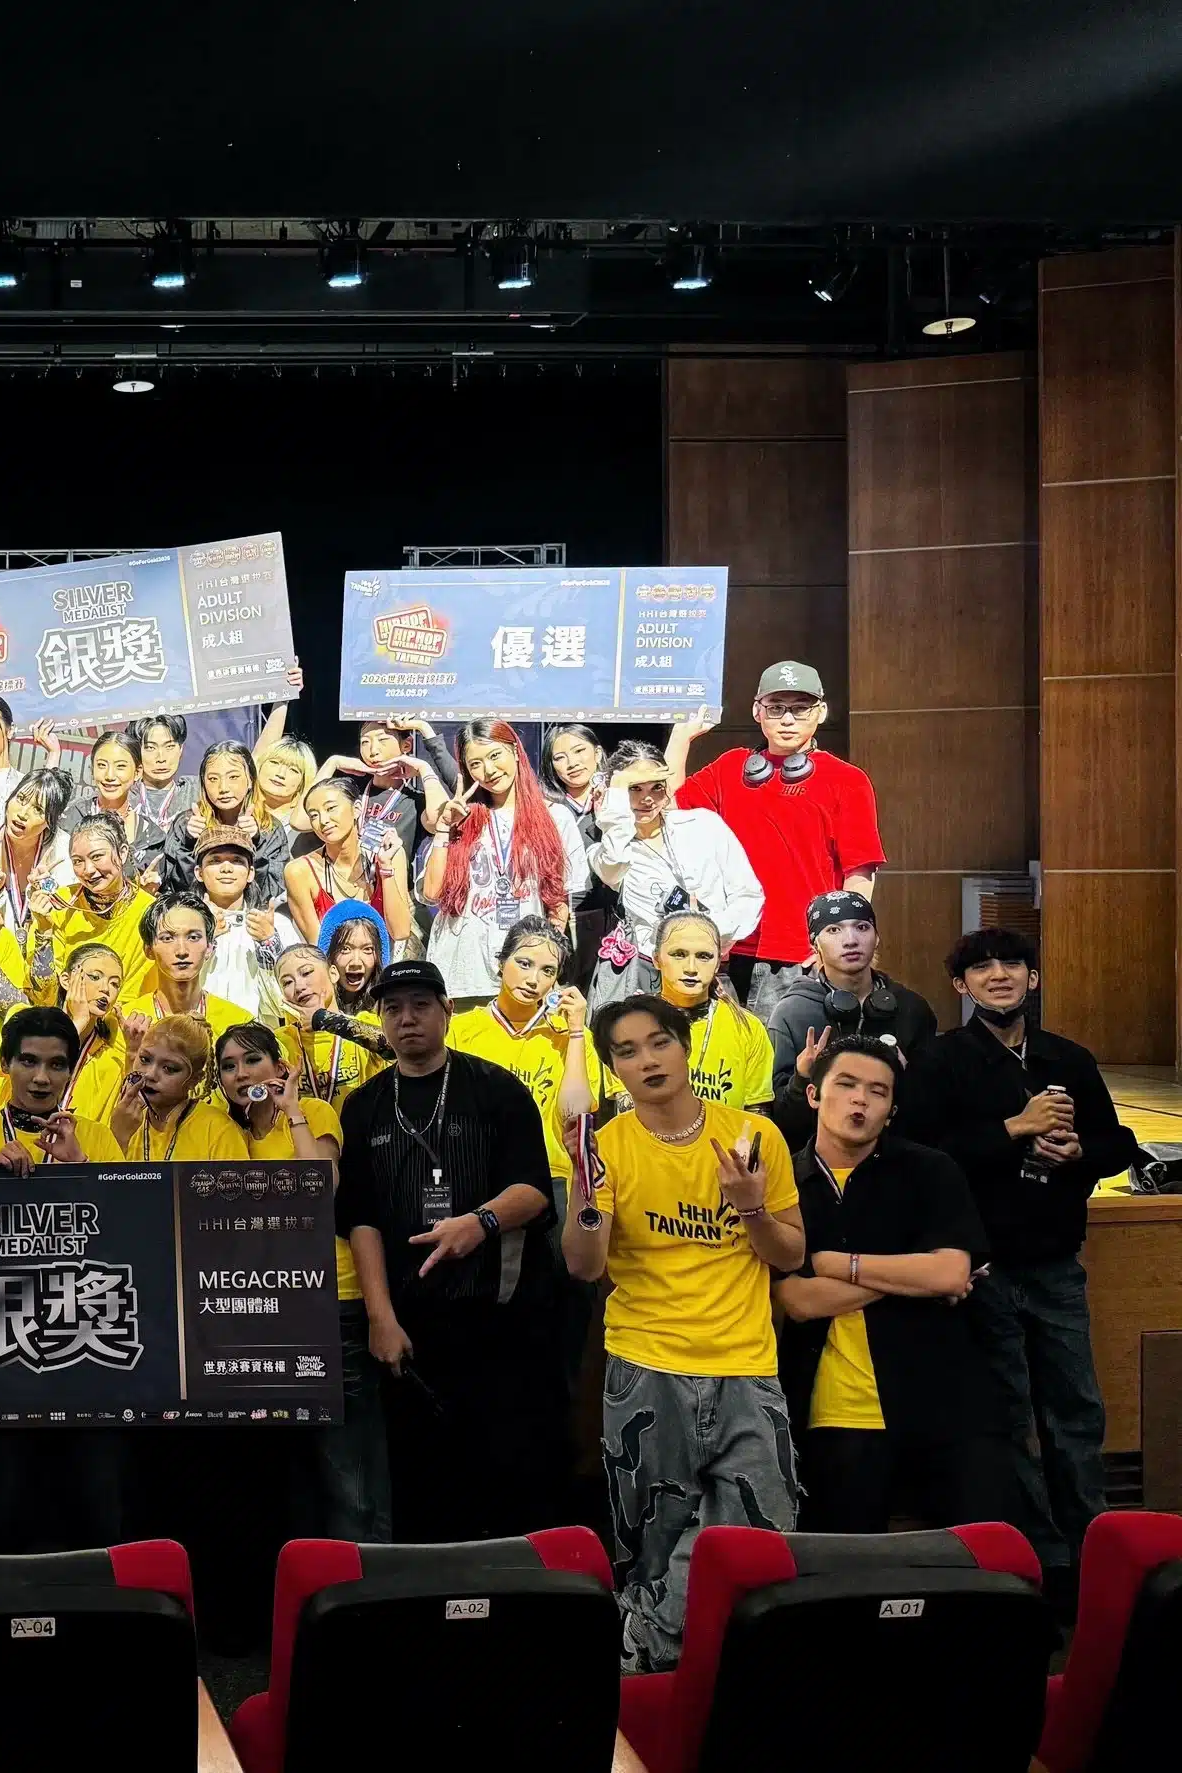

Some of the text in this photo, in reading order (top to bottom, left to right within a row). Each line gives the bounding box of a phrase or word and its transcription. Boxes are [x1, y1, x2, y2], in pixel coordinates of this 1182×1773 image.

[52, 581, 133, 612] SILVER
[197, 591, 243, 609] ADULT
[62, 602, 127, 623] MEDALIST
[199, 605, 262, 625] DIVISION
[636, 623, 678, 634] ADULT
[202, 630, 243, 649] 成人組
[394, 628, 443, 646] HIP HOP
[636, 637, 693, 648] DIVISION
[491, 625, 586, 670] 優選
[39, 620, 163, 694] 銀獎
[395, 652, 432, 665] TAIWAN
[634, 655, 672, 668] 成人組
[386, 688, 429, 697] 2026.05.09
[782, 785, 806, 797] HUF
[391, 967, 421, 978] Supreme
[98, 1173, 162, 1181] #GoForGold2026
[246, 1183, 267, 1192] DROP
[678, 1201, 714, 1225] HHI
[645, 1210, 722, 1241] TAIWAN
[199, 1270, 325, 1289] MEGACREW
[199, 1297, 279, 1315] 大型團體組
[298, 1355, 320, 1363] TAIWAN
[204, 1360, 286, 1374] 世界決賽資格權
[453, 1603, 484, 1614] A-02
[14, 1621, 53, 1635] A-04
